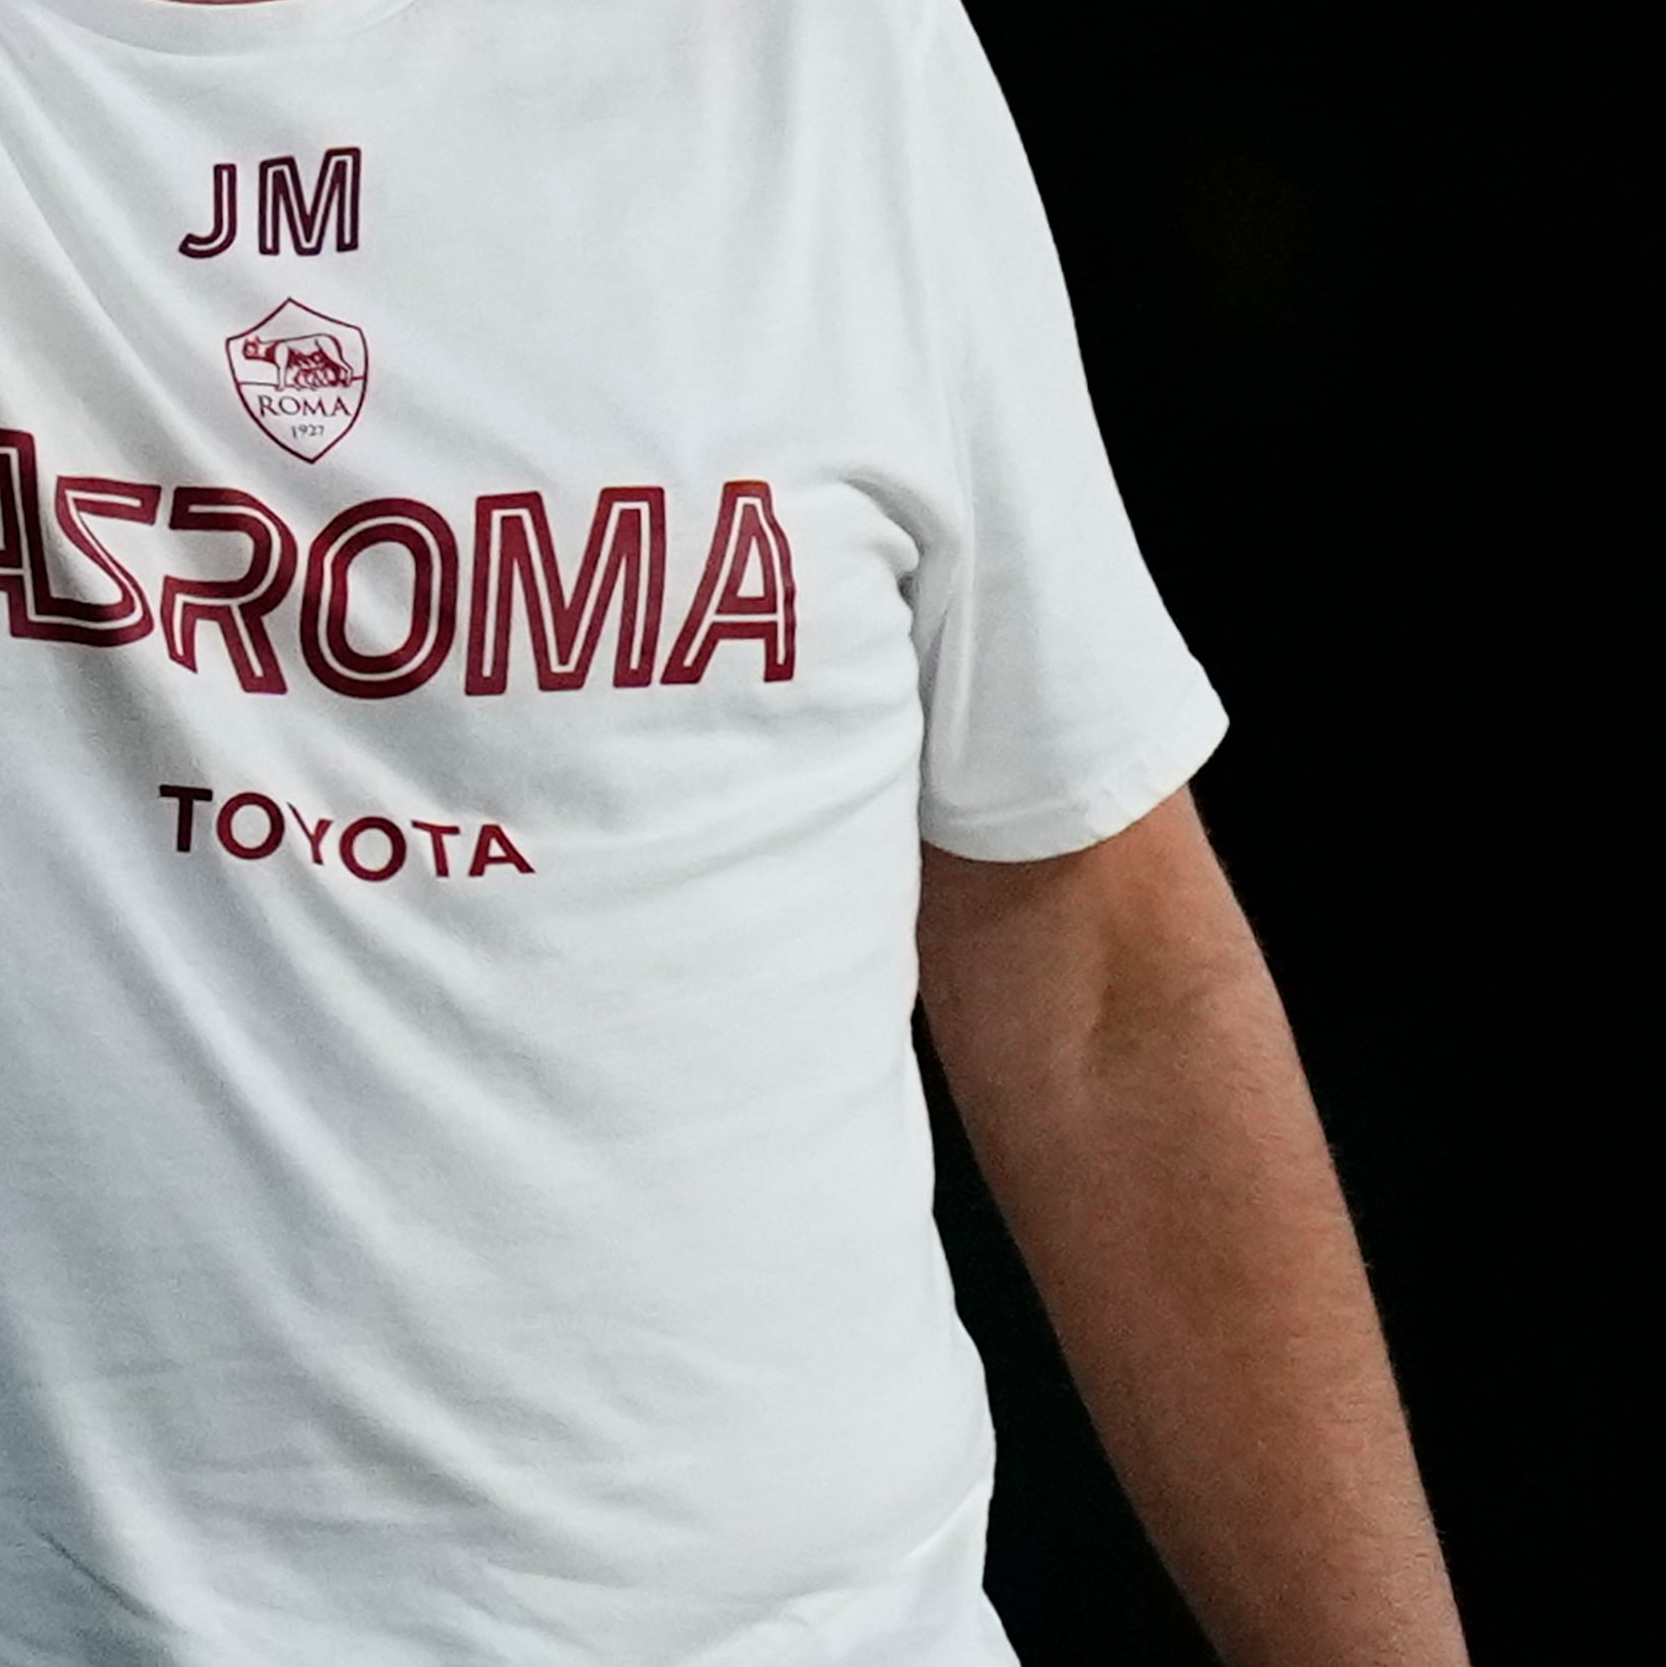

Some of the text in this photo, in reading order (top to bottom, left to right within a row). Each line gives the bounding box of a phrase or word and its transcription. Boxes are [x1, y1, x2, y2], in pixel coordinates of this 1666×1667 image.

[179, 146, 362, 259] JM
[258, 394, 351, 417] ROMA
[291, 424, 325, 439] 1927
[159, 784, 536, 883] TOYOTA
